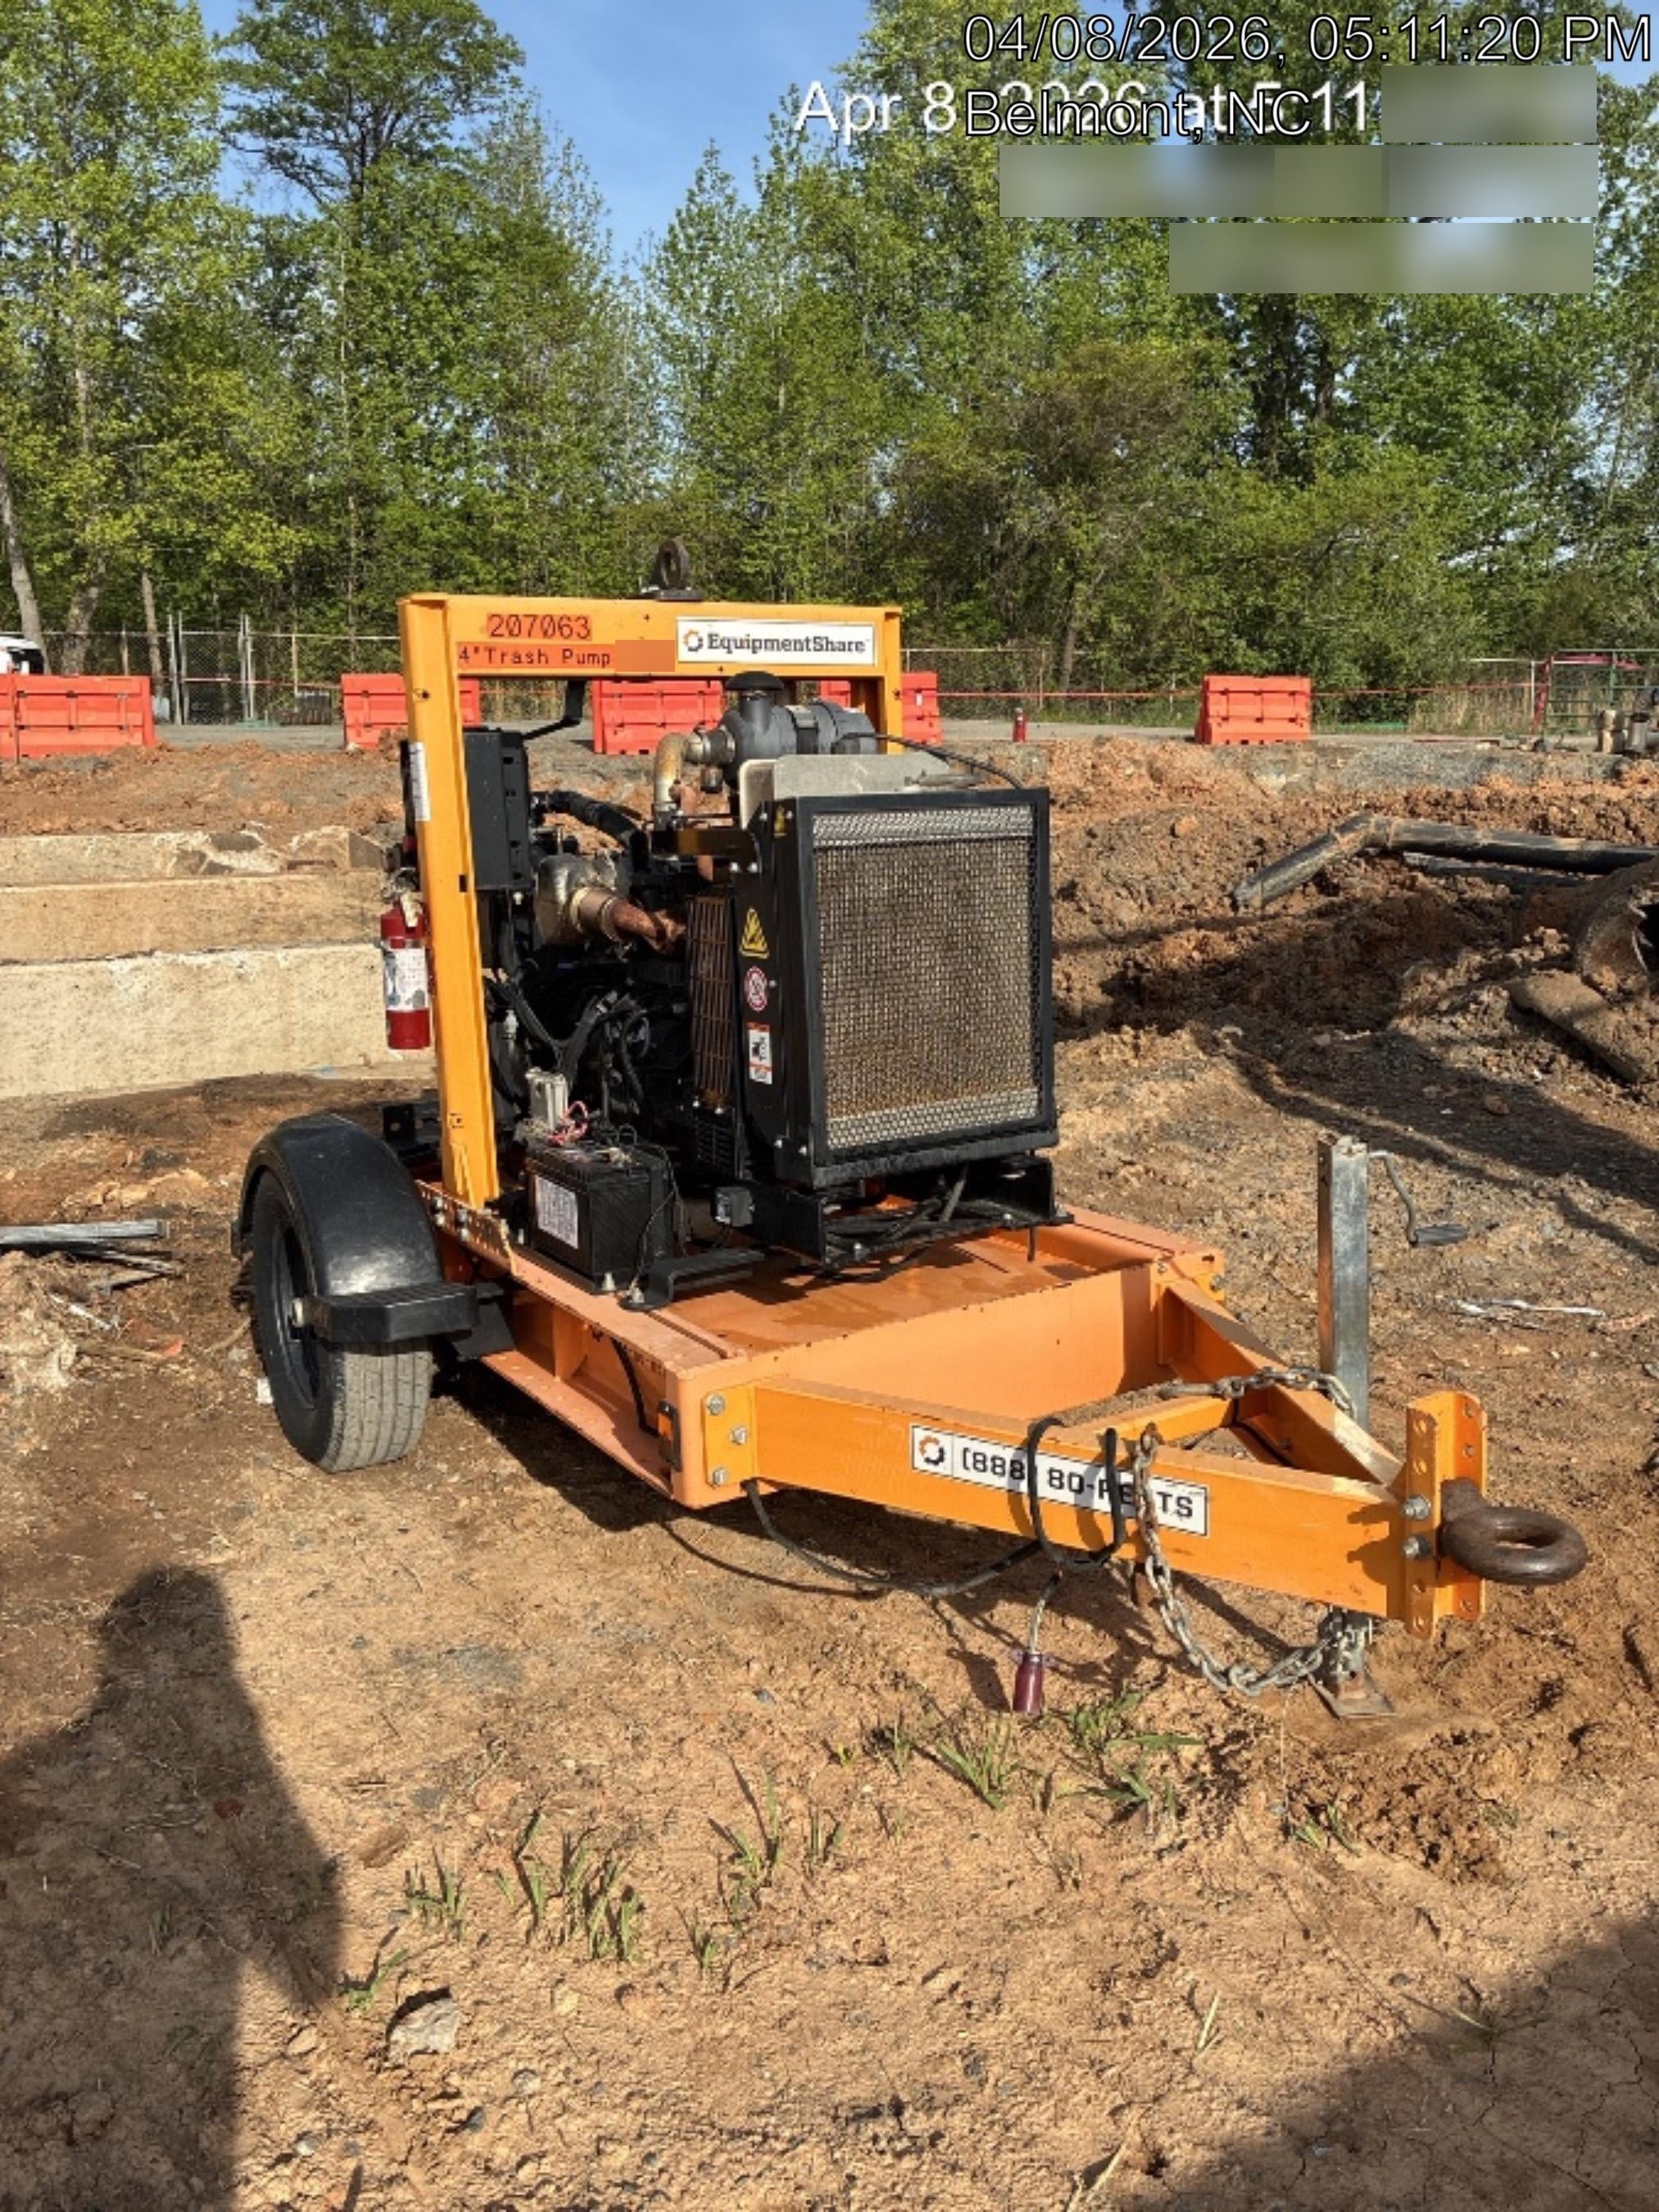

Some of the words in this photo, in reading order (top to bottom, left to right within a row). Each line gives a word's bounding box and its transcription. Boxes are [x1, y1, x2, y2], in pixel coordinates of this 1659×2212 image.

[490, 614, 591, 640] 207063
[707, 633, 866, 655] EquipmentShare
[562, 648, 610, 669] Pump
[963, 1447, 1032, 1480] (888
